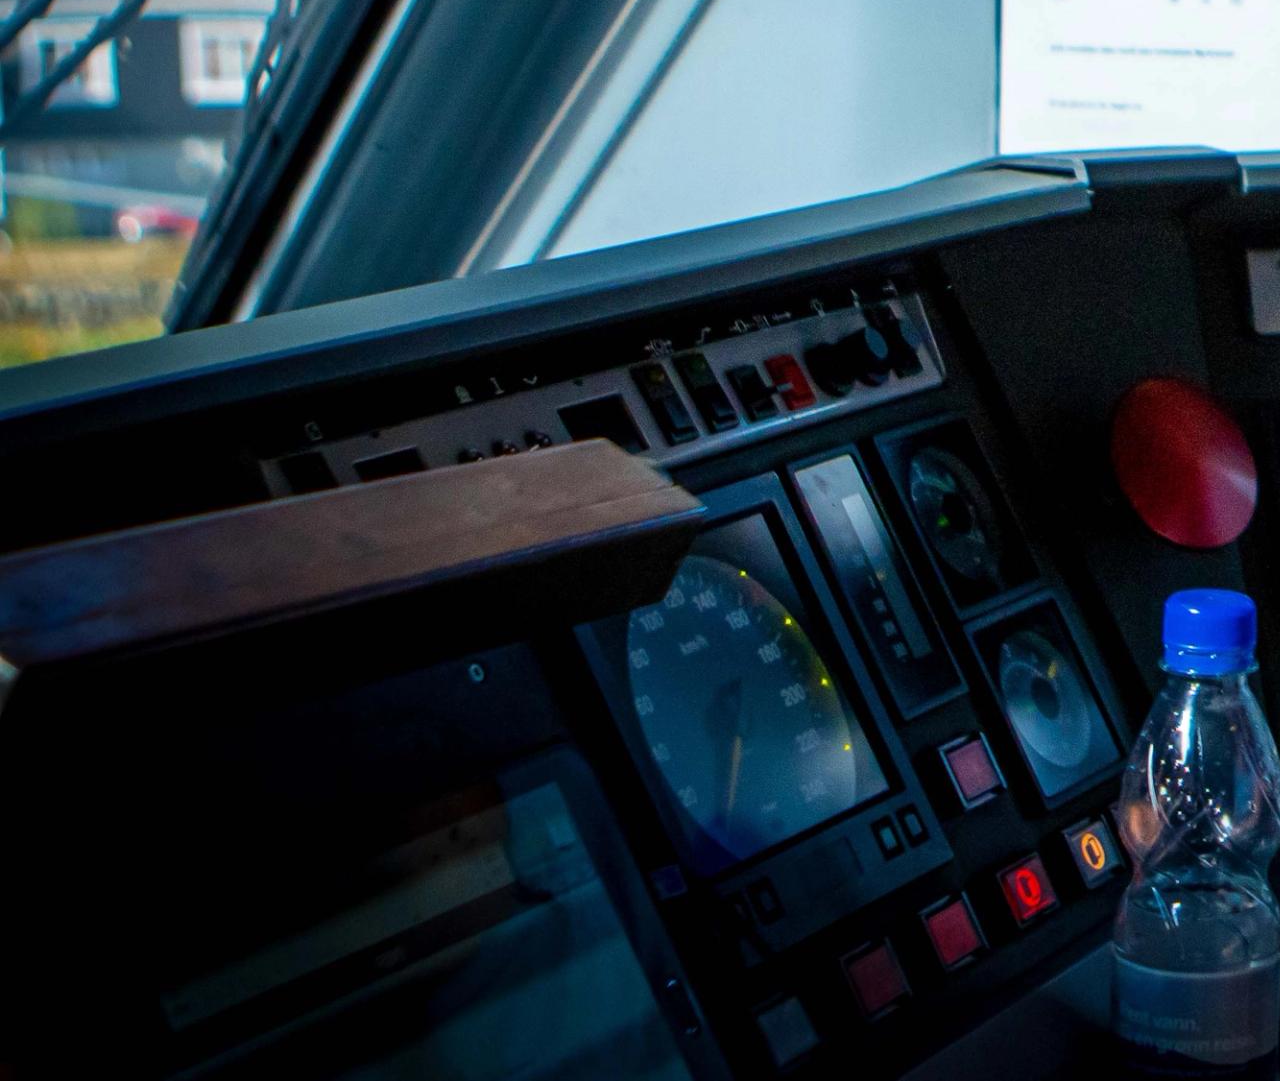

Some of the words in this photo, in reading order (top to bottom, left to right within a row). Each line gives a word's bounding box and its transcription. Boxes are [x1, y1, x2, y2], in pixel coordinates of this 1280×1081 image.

[692, 589, 717, 612] 140
[638, 610, 665, 631] 100
[780, 683, 806, 707] 200
